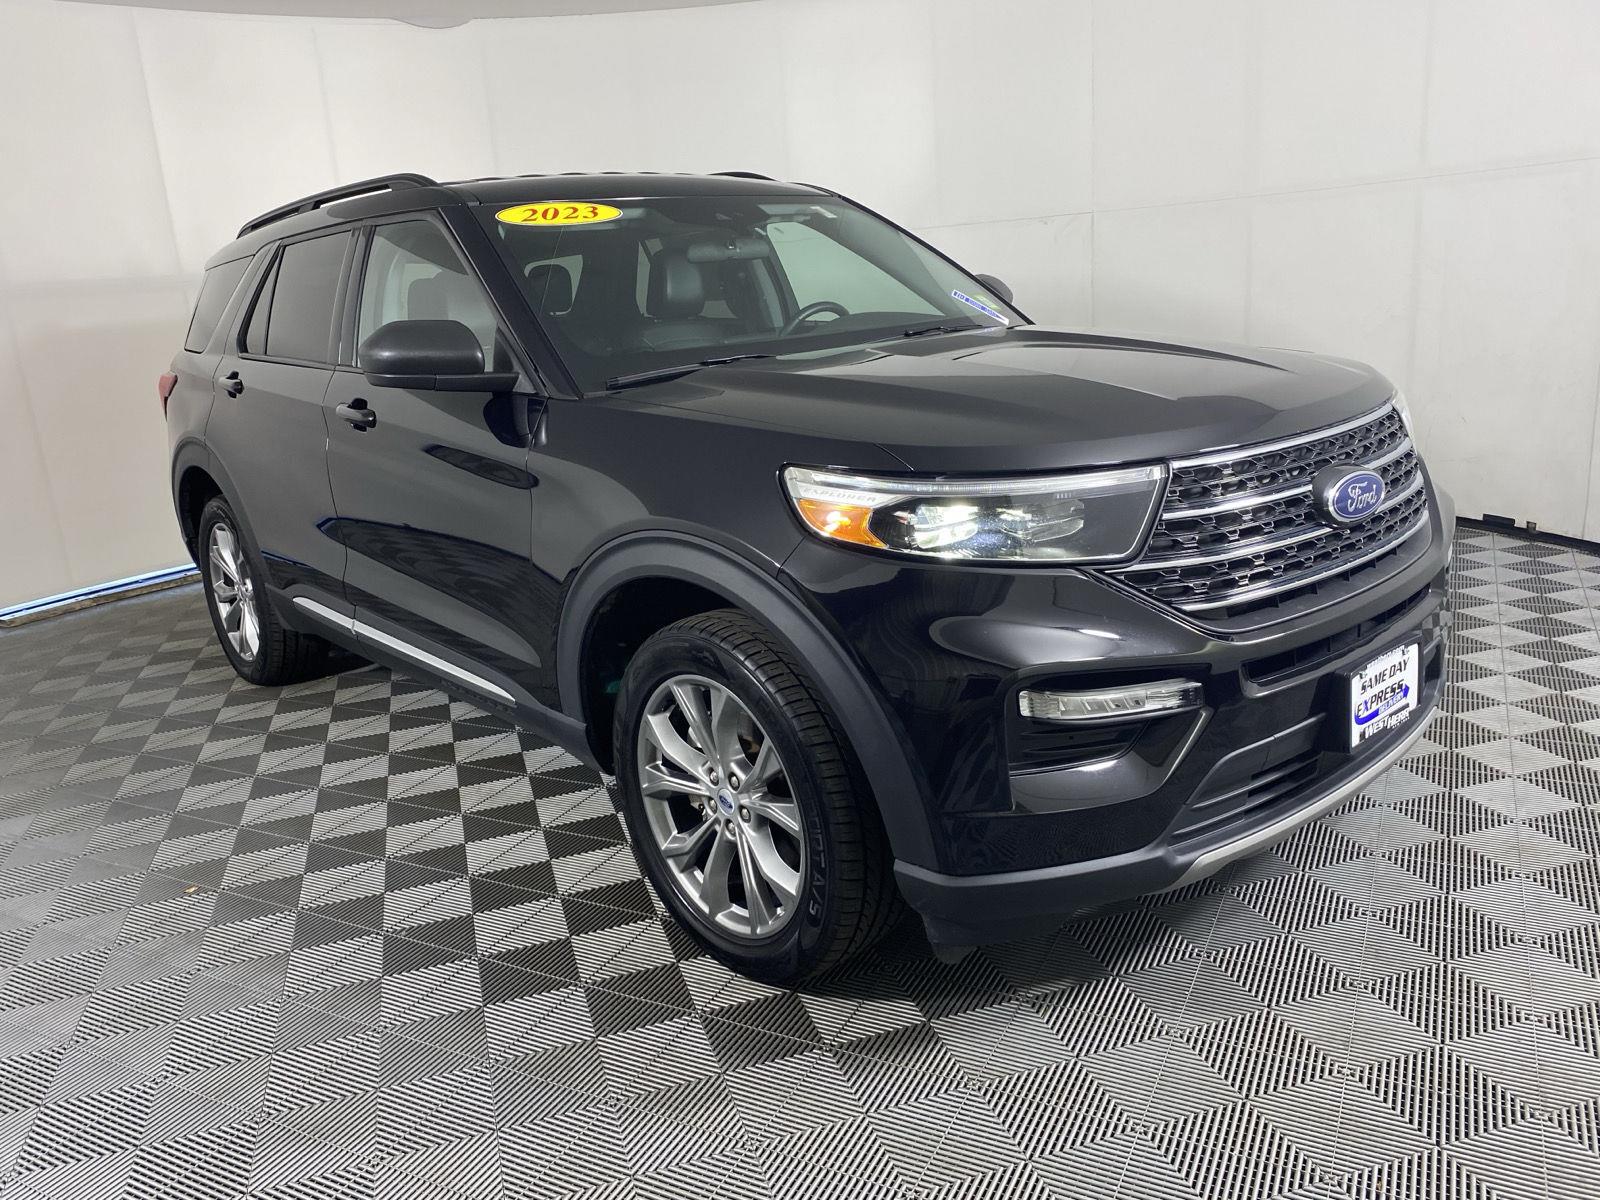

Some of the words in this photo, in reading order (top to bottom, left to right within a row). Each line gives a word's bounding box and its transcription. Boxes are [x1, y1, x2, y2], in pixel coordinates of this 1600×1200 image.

[520, 206, 599, 222] 2023
[1348, 481, 1377, 512] Ford
[1361, 668, 1388, 695] SAME
[1389, 657, 1409, 678] DAY
[1357, 679, 1404, 718] EXPRESS
